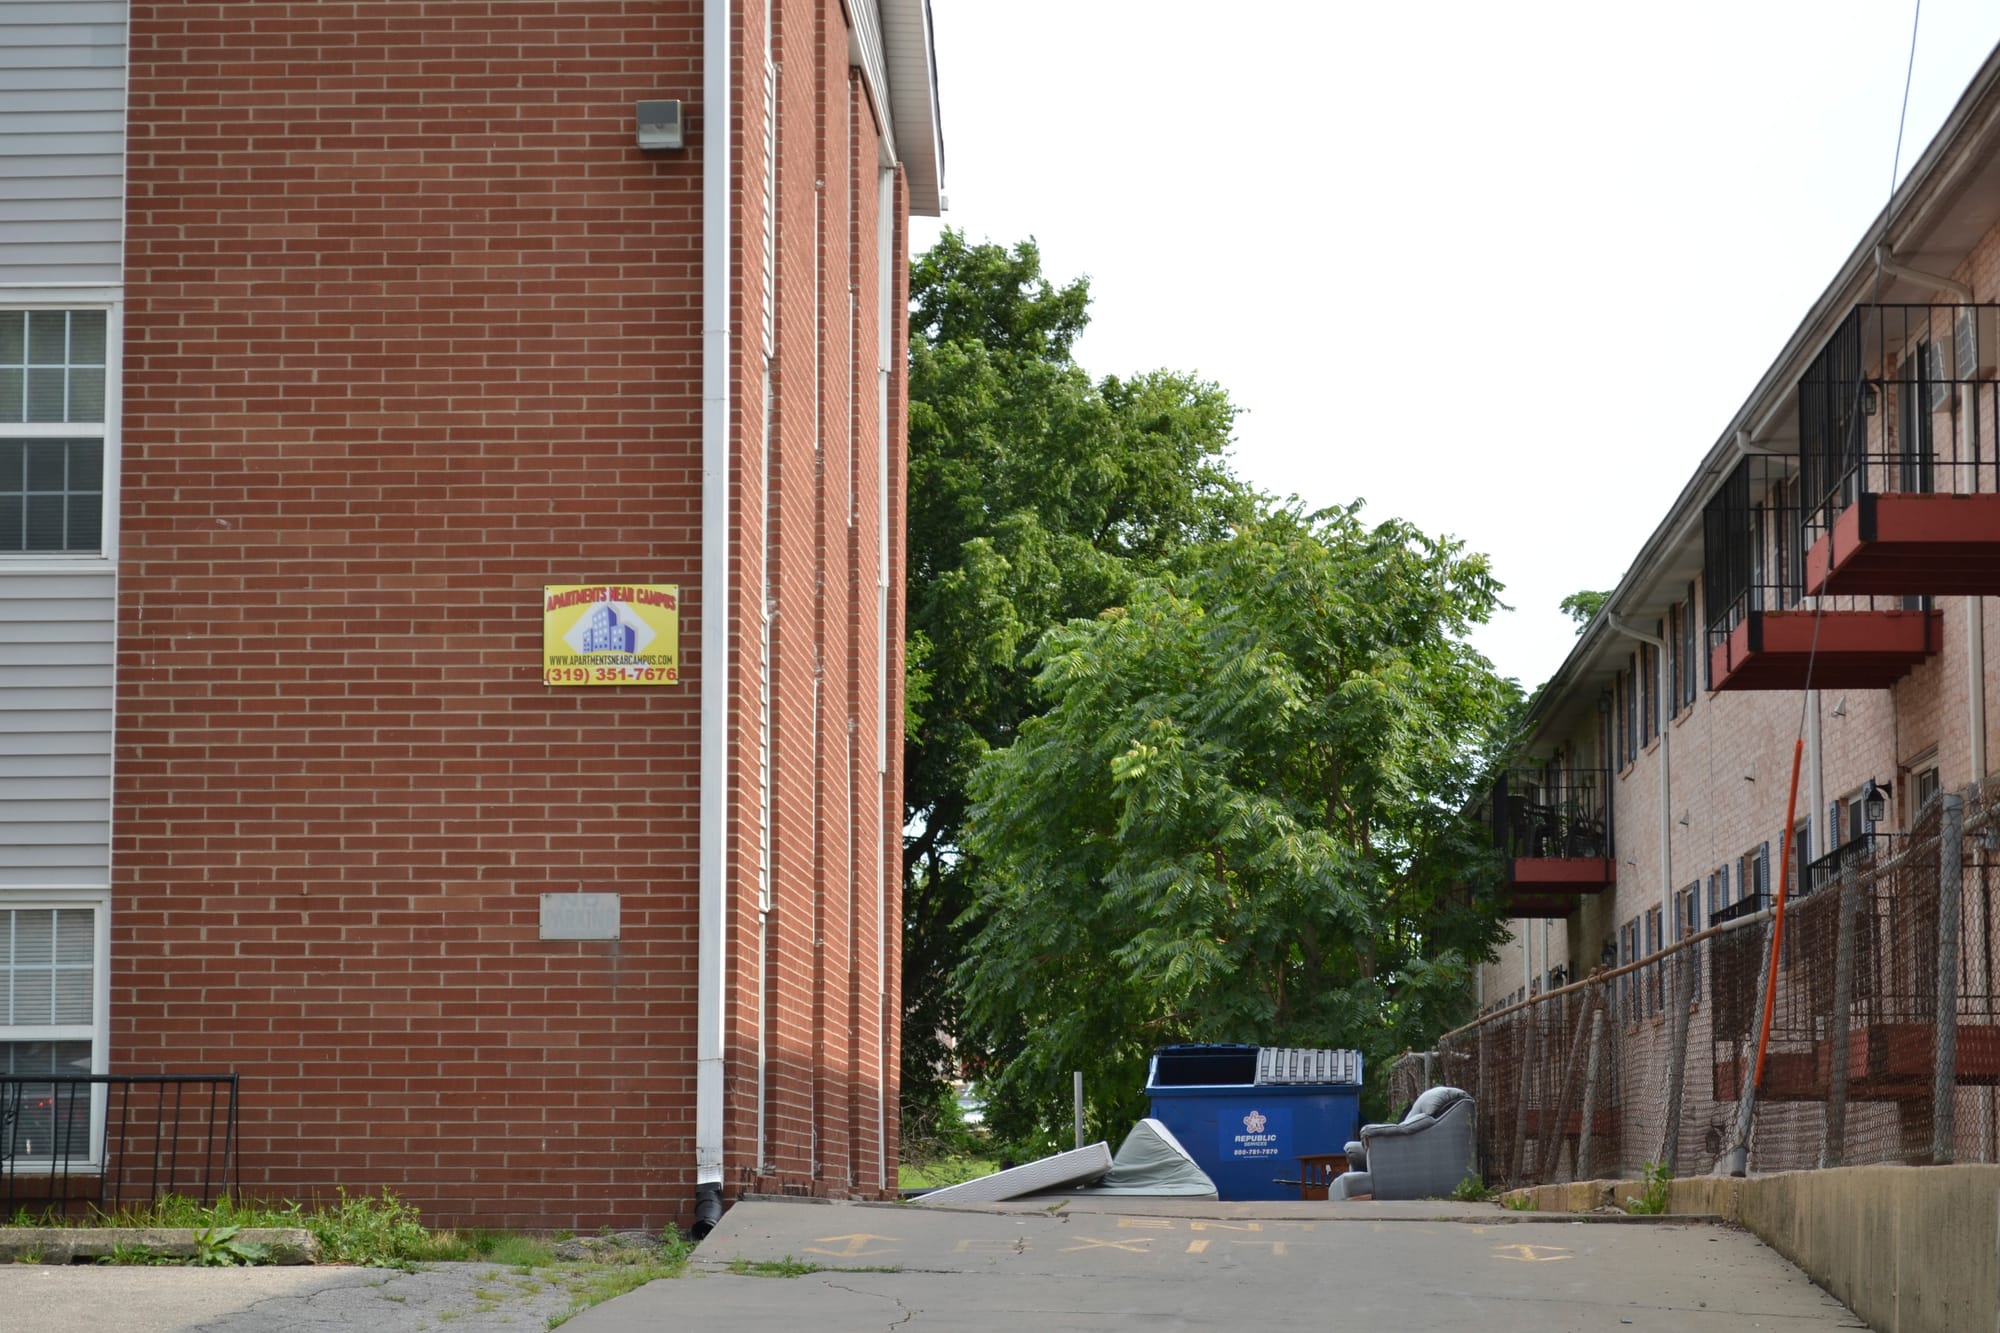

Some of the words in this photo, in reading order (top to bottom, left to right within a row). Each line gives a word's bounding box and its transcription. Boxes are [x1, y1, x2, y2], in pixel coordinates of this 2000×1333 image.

[546, 587, 607, 612] APARTMENTS
[609, 586, 634, 602] NEAR
[637, 588, 676, 611] CAMPUS
[549, 655, 673, 666] WWW.APARTMENTSNEARCAMPUS.COM
[545, 668, 590, 684] (319)
[595, 667, 677, 681] 351-7676
[1235, 1134, 1276, 1142] REPUBLIC
